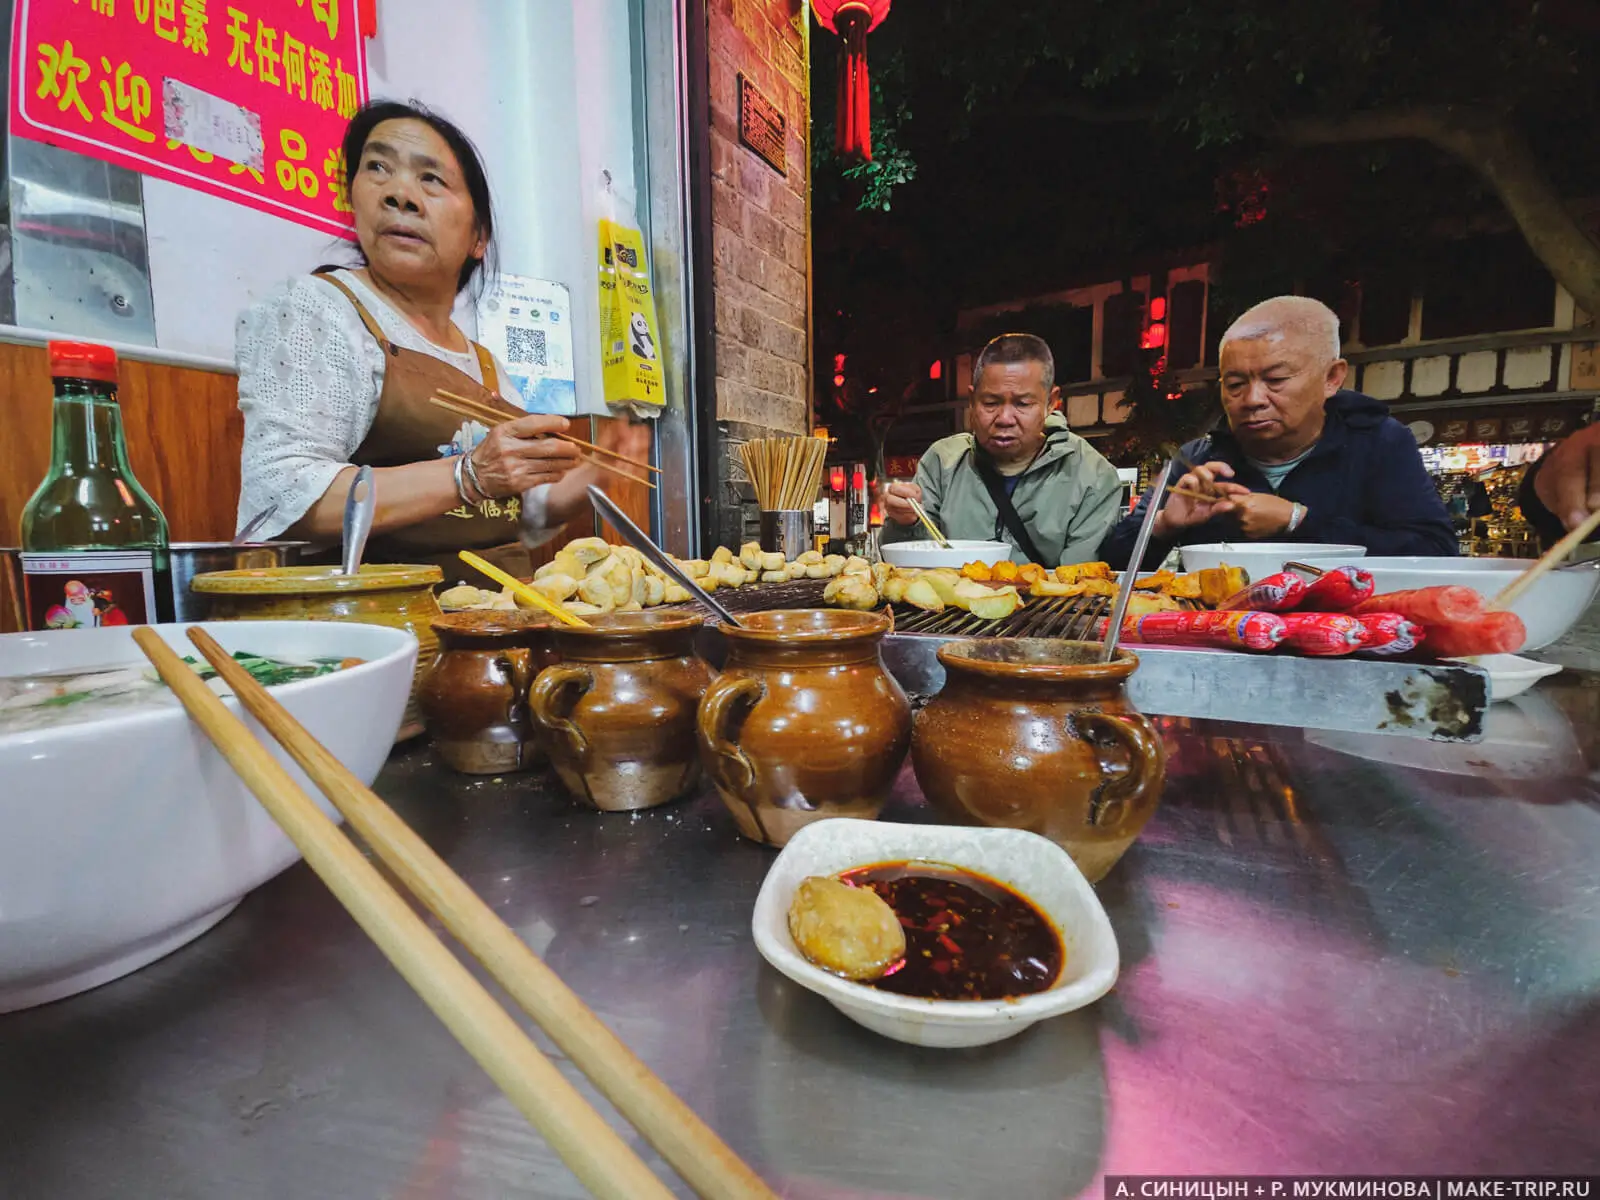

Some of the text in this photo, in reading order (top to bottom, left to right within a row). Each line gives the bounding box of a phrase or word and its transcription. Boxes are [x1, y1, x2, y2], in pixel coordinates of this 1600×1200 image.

[226, 7, 357, 120] 无任何添加
